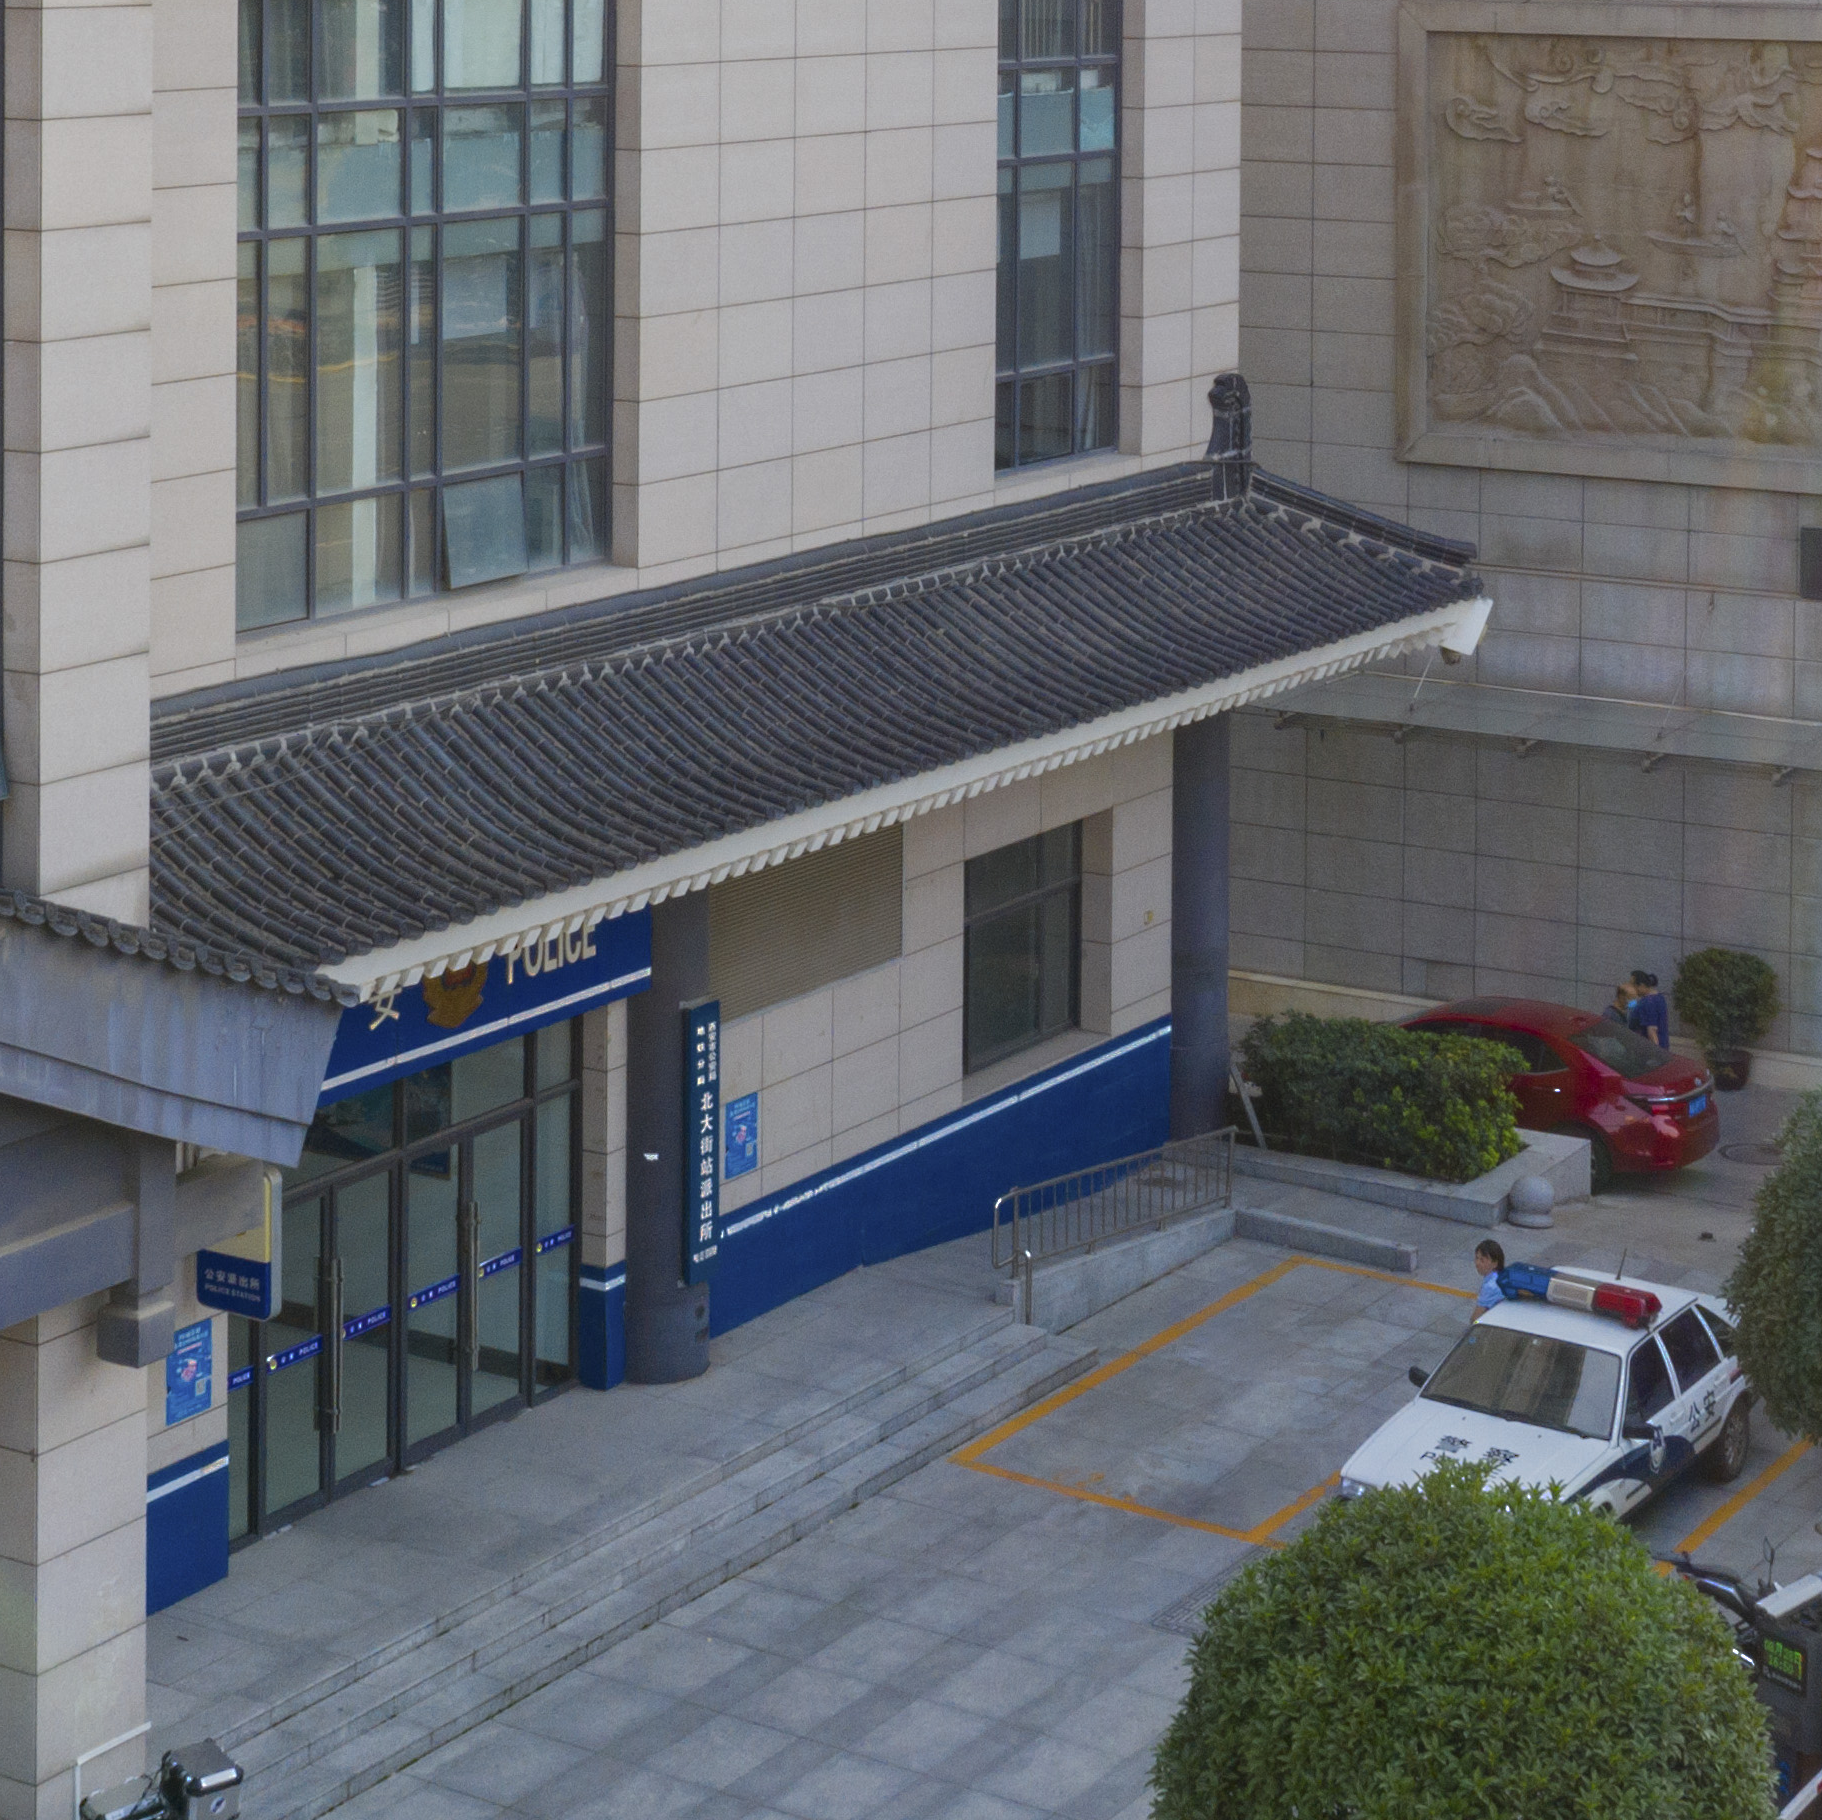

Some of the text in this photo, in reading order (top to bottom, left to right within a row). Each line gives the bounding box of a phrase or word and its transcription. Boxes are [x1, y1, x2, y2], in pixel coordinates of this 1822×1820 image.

[506, 924, 597, 985] POLICE
[699, 1091, 714, 1243] 北大街站派出所
[204, 1267, 260, 1291] 公安派出所
[1688, 1389, 1716, 1433] 公安
